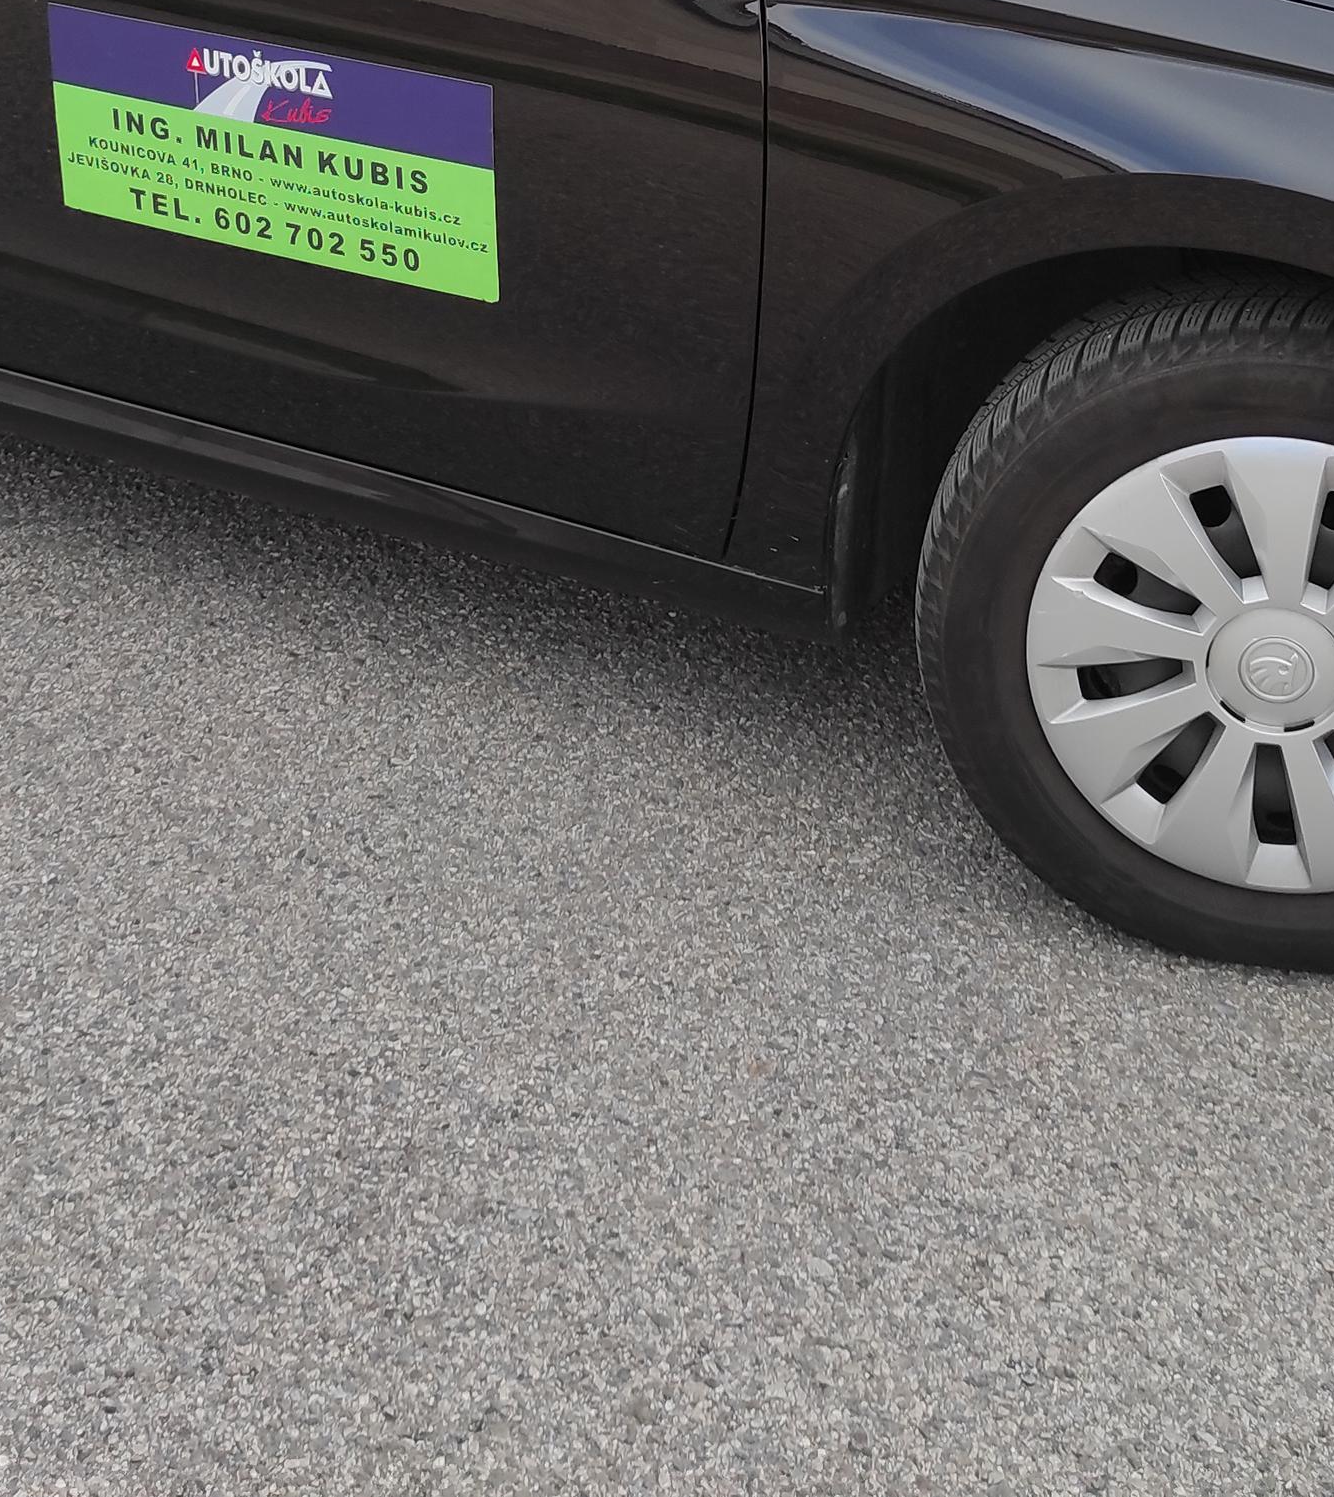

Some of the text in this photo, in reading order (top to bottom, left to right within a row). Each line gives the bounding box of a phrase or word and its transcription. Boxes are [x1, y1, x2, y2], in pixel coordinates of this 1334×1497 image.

[187, 47, 333, 99] AUTOŠKOLA
[261, 96, 331, 123] Kubis
[88, 136, 177, 166] KOUNICOVA
[182, 158, 205, 175] 41,
[211, 162, 253, 182] BRNO
[269, 176, 462, 226] www.autoskola-kubis.cz
[112, 108, 429, 194] ING. MILAN KUBIS
[67, 151, 151, 180] JEVIŠOVKA
[156, 171, 179, 189] 28,
[184, 177, 267, 205] DRNHOLEC
[284, 201, 490, 253] www.autoskolamikulov.cz
[129, 187, 421, 272] TEL. 602 702 550
